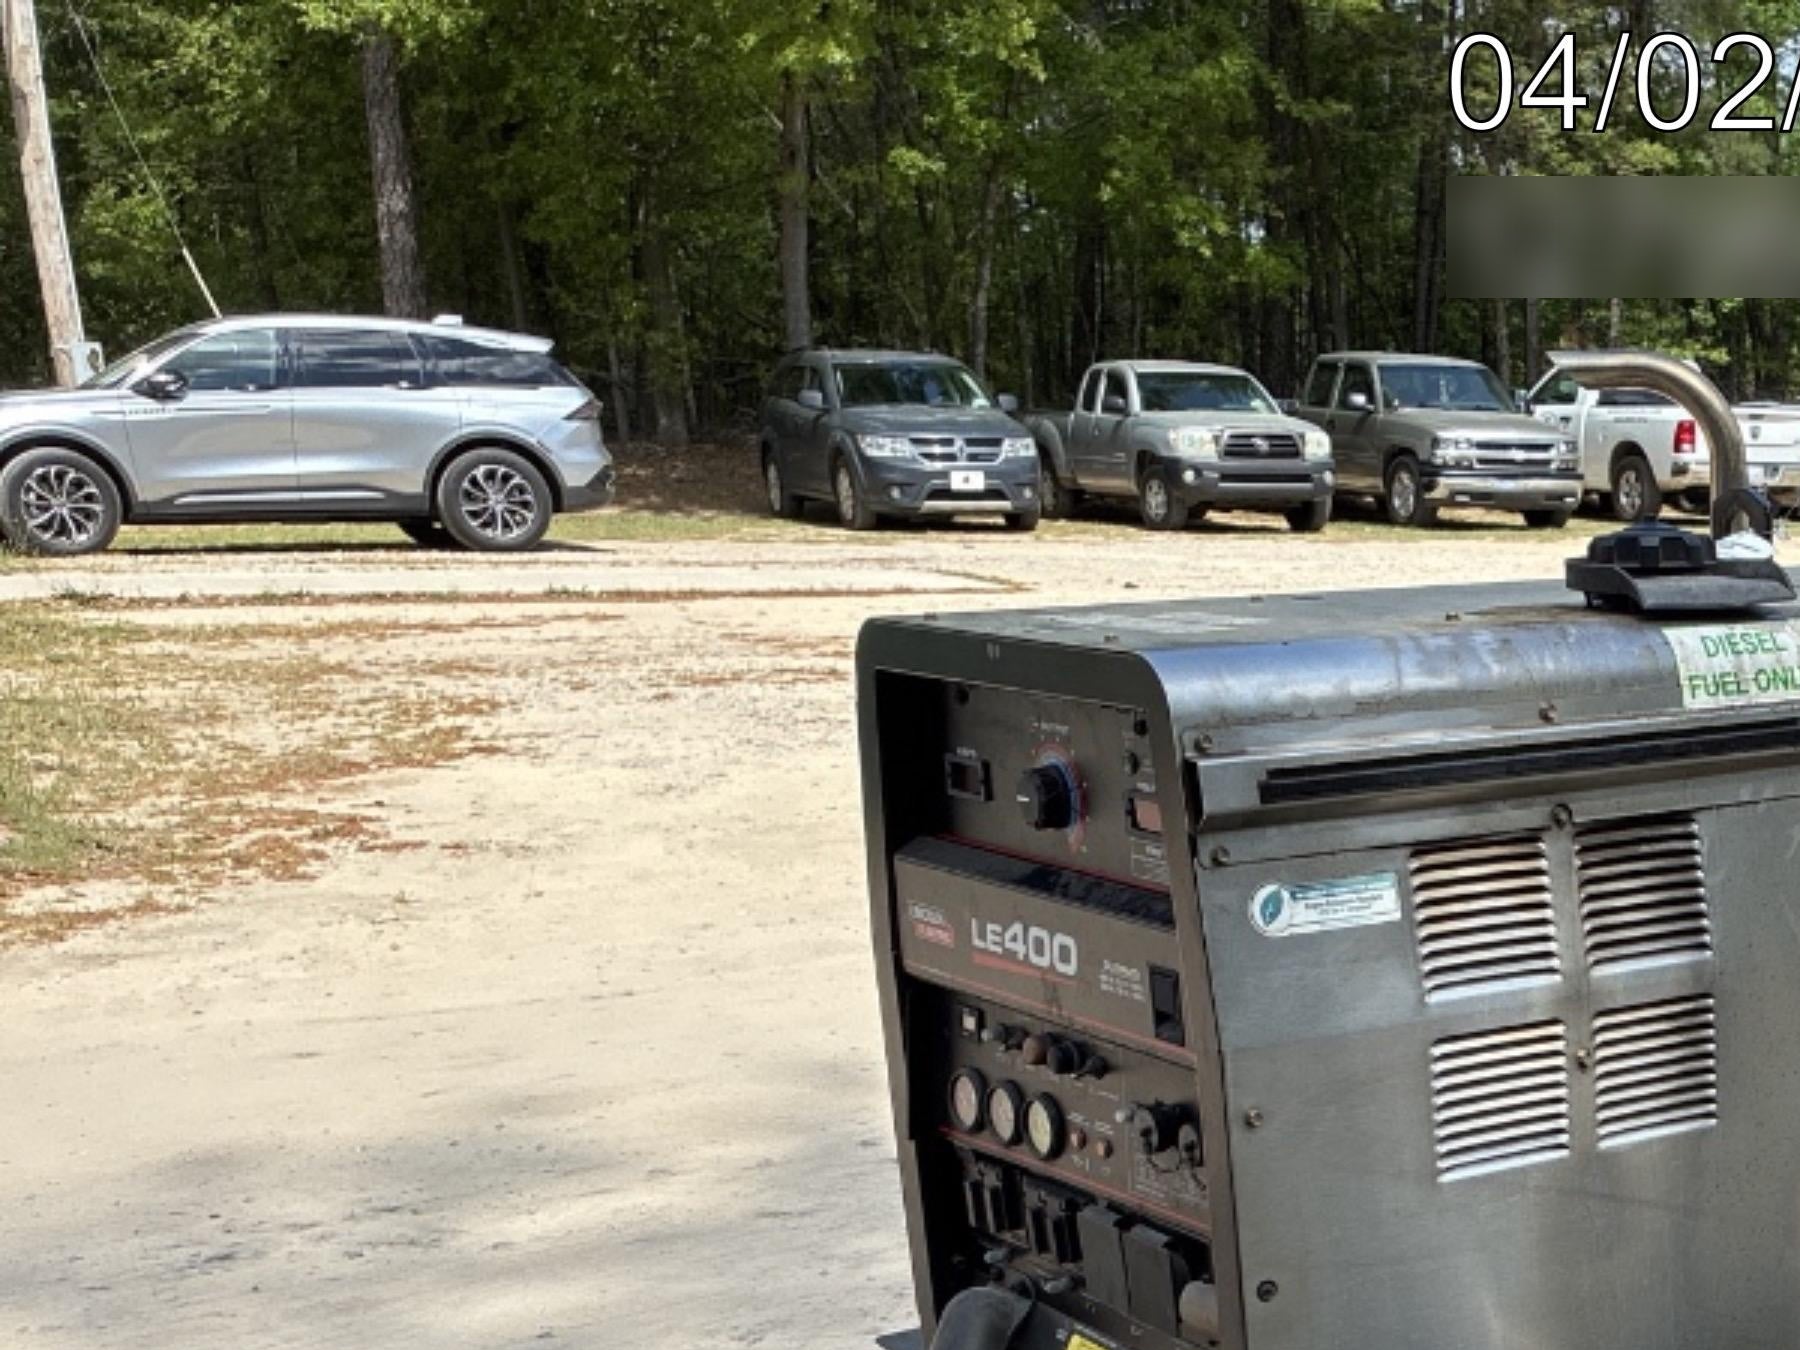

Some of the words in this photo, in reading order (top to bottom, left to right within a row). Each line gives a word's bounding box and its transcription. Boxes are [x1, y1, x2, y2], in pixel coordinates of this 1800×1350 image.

[1700, 631, 1789, 659] DIESEL
[1688, 671, 1749, 699] FUEL
[971, 917, 1078, 976] LE400
